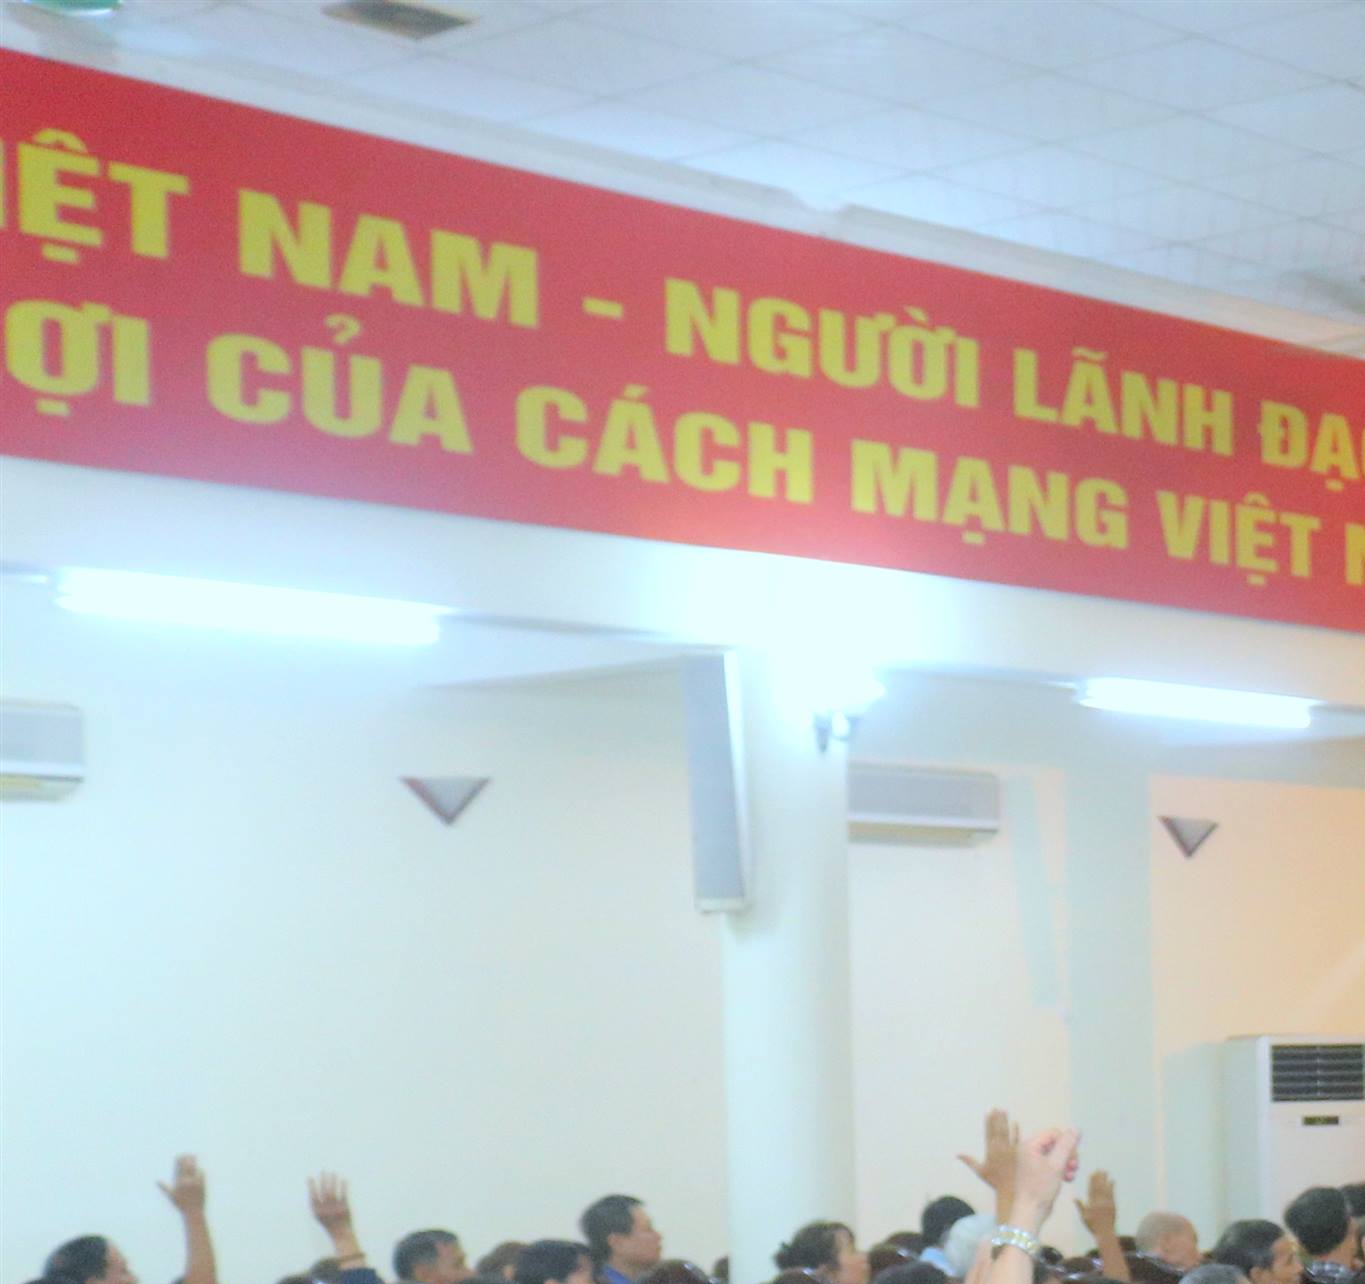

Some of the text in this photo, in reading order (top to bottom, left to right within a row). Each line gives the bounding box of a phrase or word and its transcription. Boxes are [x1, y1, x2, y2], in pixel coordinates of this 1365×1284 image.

[0, 127, 190, 264] ỆT
[237, 188, 540, 330] NAM
[583, 297, 624, 320] -
[664, 277, 981, 409] NGƯỜI
[1012, 346, 1235, 458] LÃNH
[205, 312, 474, 456] CỦA
[515, 383, 815, 506] CÁCH
[850, 437, 1130, 546] MẠNG
[1155, 491, 1322, 586] VIỆT
